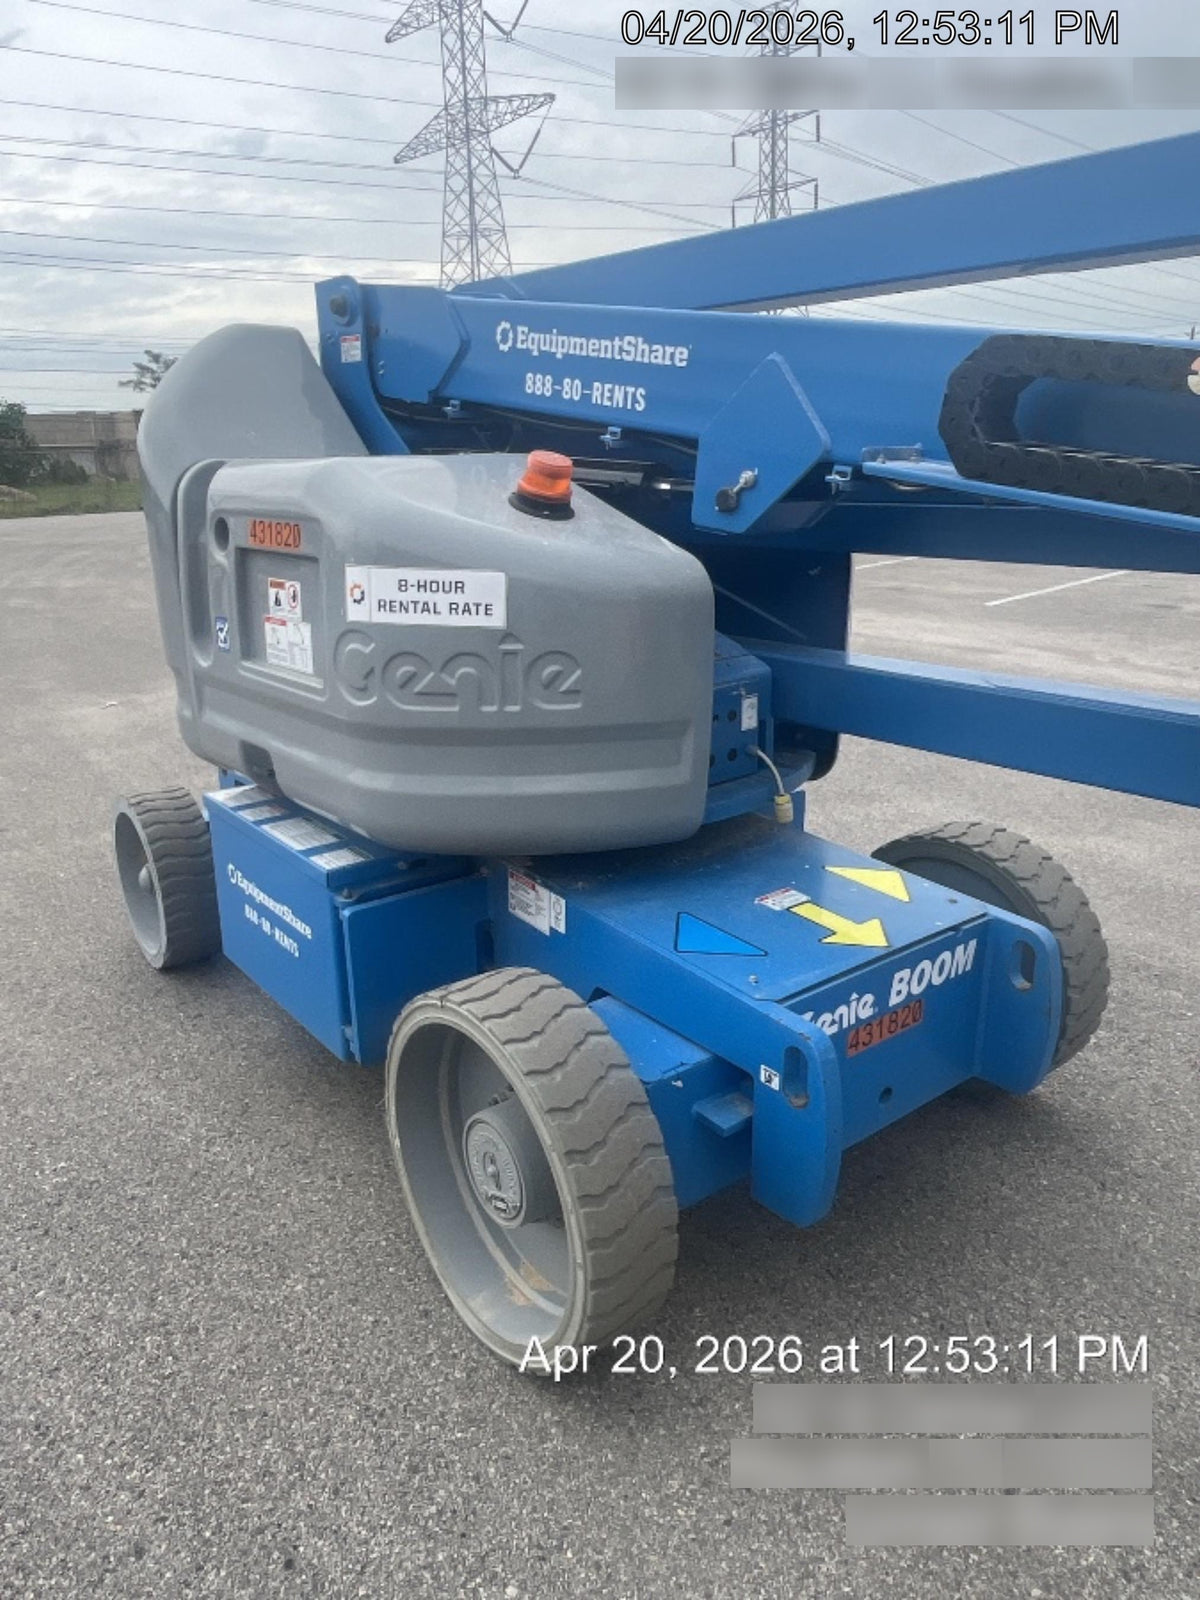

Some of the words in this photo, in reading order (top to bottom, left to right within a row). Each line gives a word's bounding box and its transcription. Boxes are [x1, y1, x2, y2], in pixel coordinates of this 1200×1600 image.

[516, 325, 689, 367] EquipmentShare
[525, 372, 647, 411] 888-80-RENTS
[250, 519, 301, 548] 431820
[397, 578, 466, 595] 8-HOUR
[377, 598, 442, 616] RENTAL
[449, 602, 494, 617] RATE
[333, 628, 582, 712] Genie
[888, 938, 978, 1007] BOOM
[848, 999, 923, 1053] 431820
